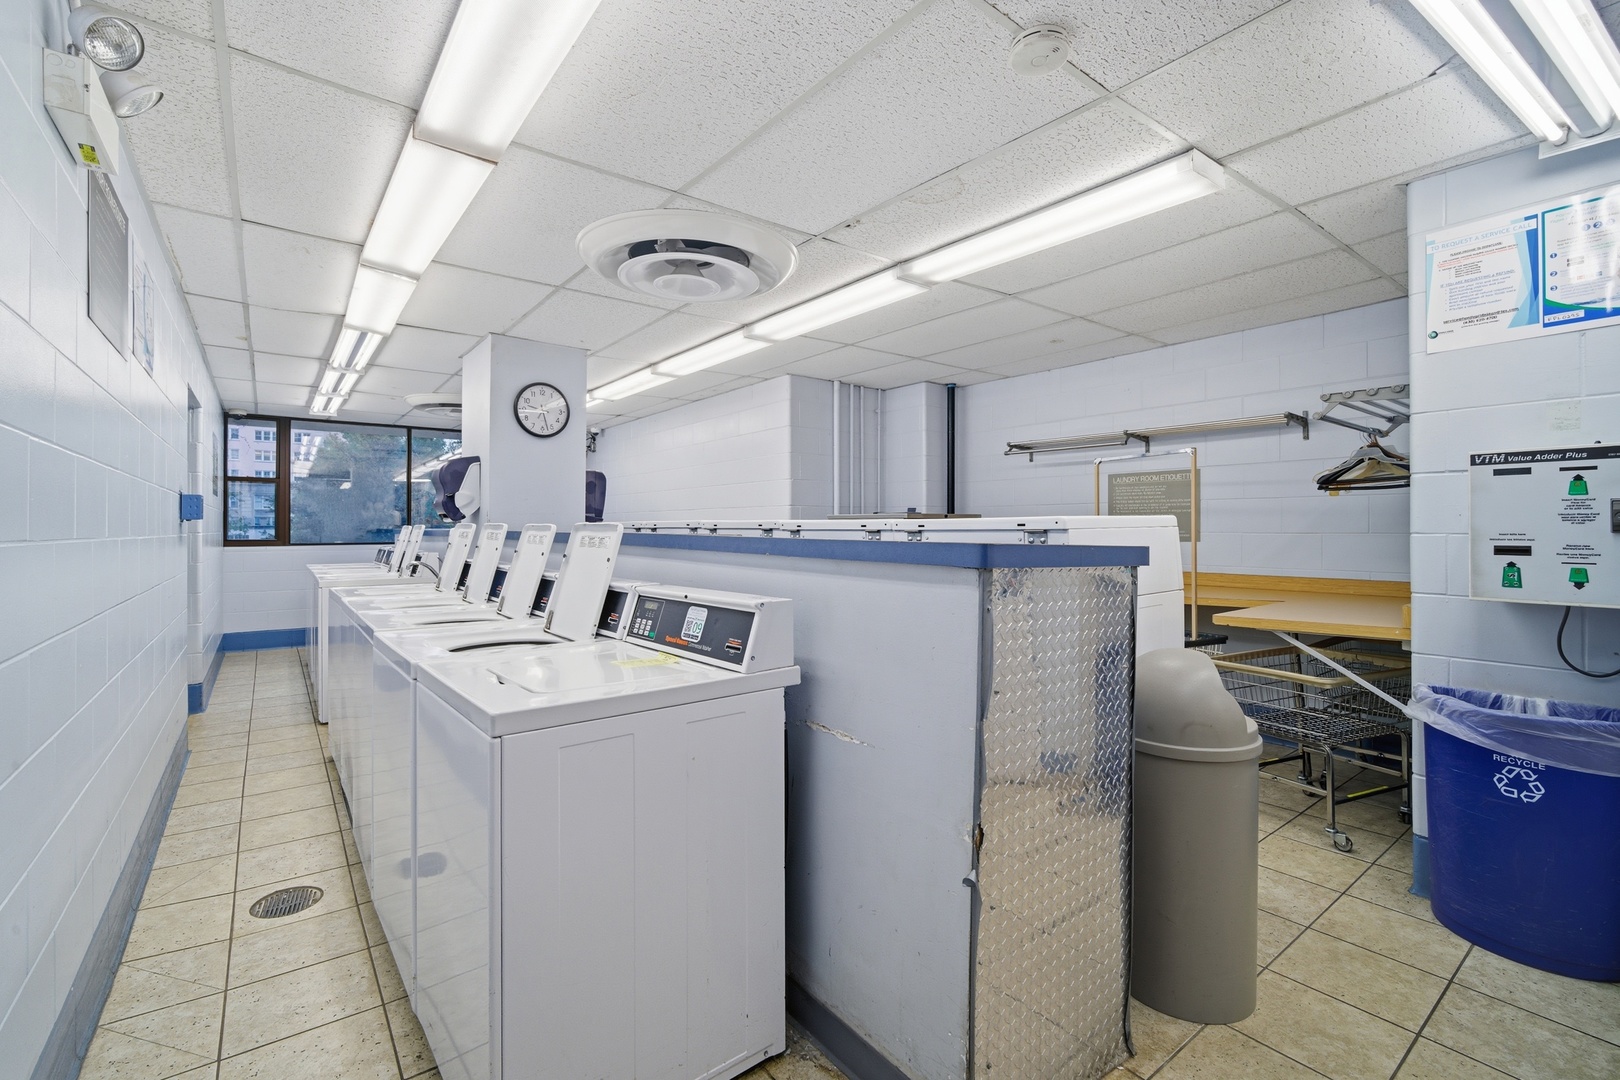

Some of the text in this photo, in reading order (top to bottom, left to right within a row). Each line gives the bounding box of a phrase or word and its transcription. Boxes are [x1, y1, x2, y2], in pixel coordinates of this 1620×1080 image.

[1430, 244, 1440, 252] TO
[1441, 237, 1473, 250] REQUEST
[1481, 227, 1511, 240] SERVICE
[1512, 222, 1533, 232] CALL
[1474, 451, 1588, 464] VTM Value Adder Plus
[1112, 472, 1192, 485] LAUNDRY ROOM ETIQUETT
[692, 621, 703, 634] 09
[1493, 753, 1546, 771] RECYCLE
